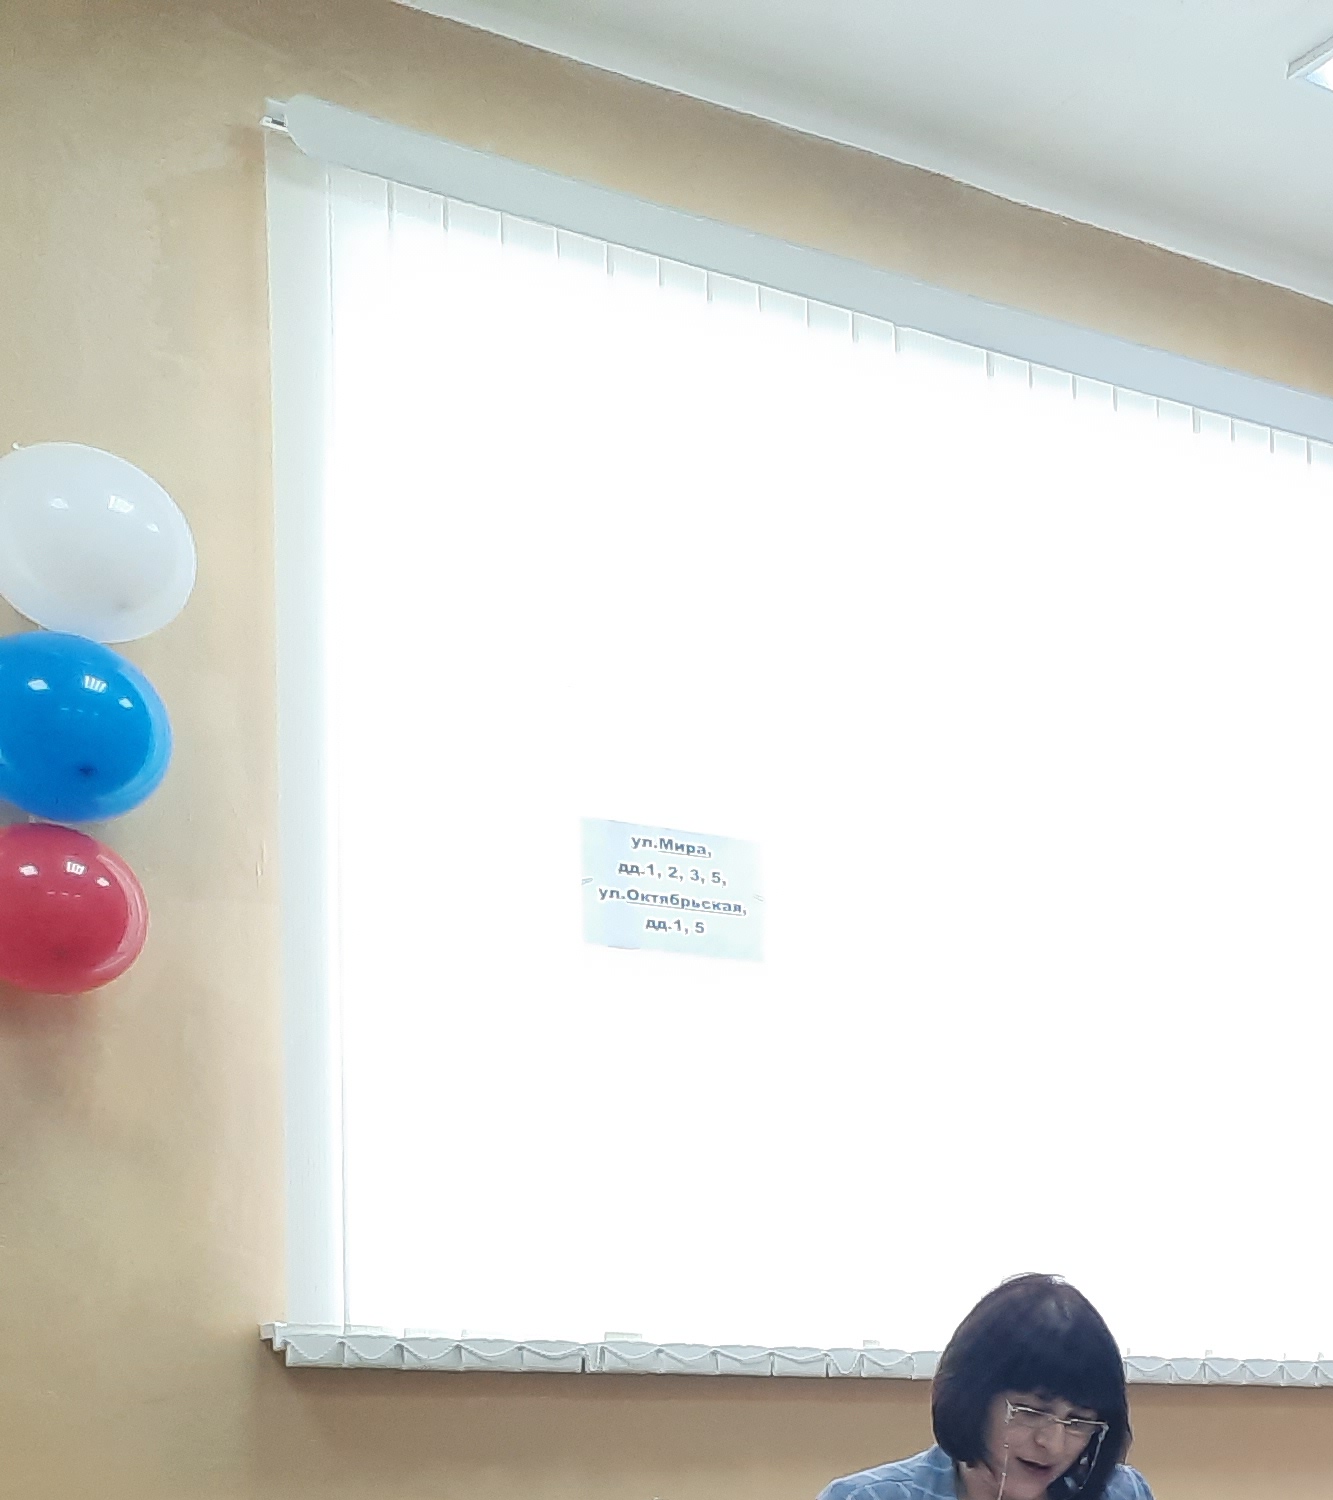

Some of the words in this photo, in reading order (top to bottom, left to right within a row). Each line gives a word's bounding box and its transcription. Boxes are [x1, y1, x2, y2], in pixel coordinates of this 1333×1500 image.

[631, 836, 712, 858] ул.Мира,
[618, 862, 661, 879] дд.1,
[668, 866, 684, 882] 2,
[690, 869, 705, 884] 3,
[711, 872, 727, 887] 5,
[599, 887, 747, 916] ул.Октябрьская,
[646, 919, 689, 935] дд.1,
[695, 922, 705, 934] 5
